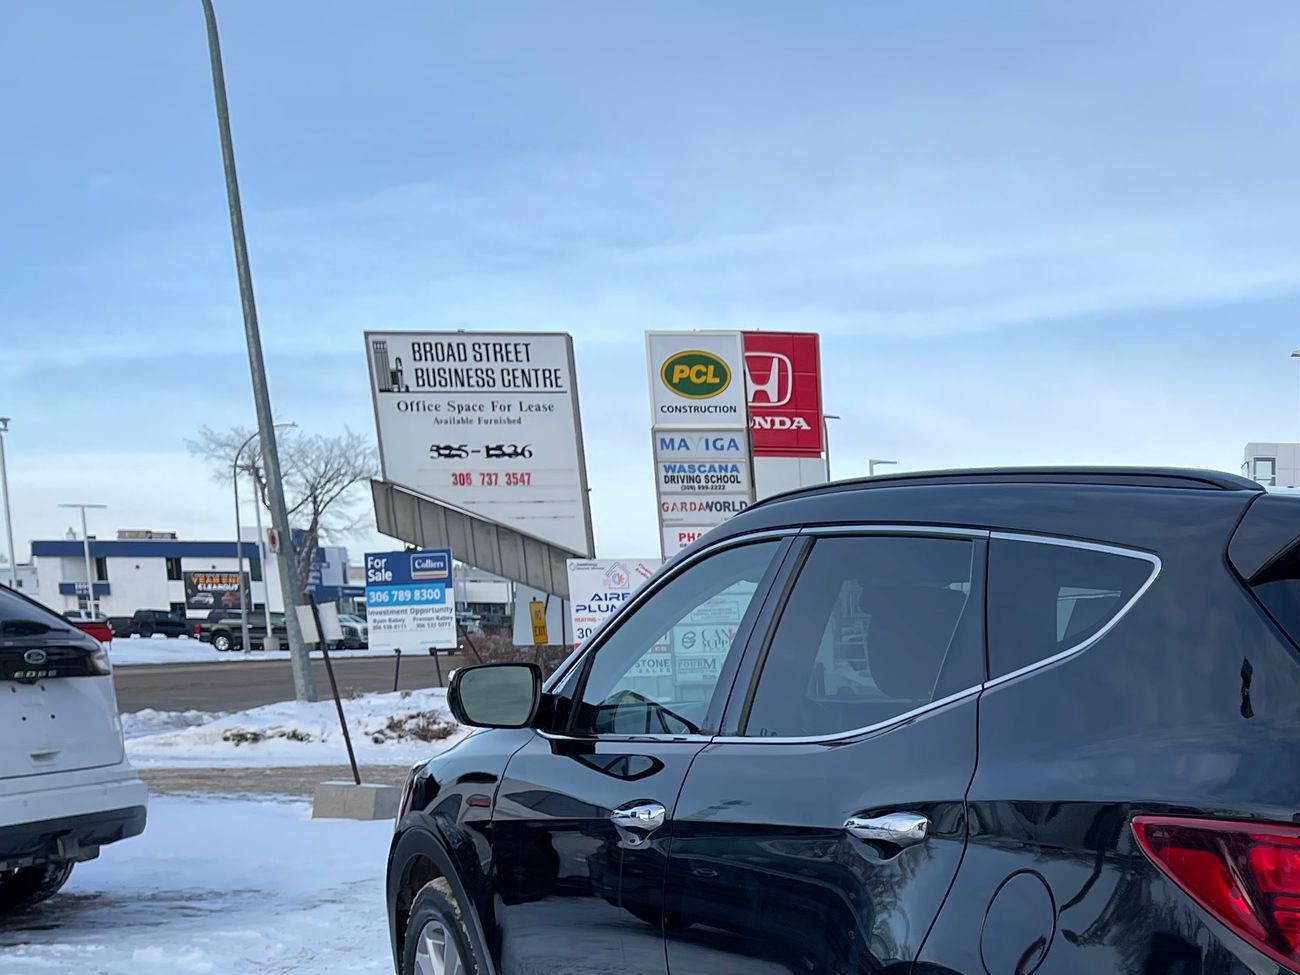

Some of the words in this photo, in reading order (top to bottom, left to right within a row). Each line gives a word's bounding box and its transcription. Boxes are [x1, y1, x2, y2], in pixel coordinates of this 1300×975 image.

[411, 342, 467, 362] BROAD
[472, 342, 531, 363] STREET
[415, 367, 496, 388] BUSINESS
[501, 368, 563, 388] CENTRE
[672, 364, 720, 384] PCL
[397, 400, 441, 412] Office
[447, 400, 485, 414] Space
[491, 401, 512, 412] For
[519, 401, 554, 412] Lease
[660, 405, 737, 413] CONSTRUCTION
[433, 417, 473, 425] Available
[478, 417, 522, 425] Furnished
[749, 416, 811, 430] NDA
[663, 464, 740, 473] WASCANA
[452, 473, 472, 486] 306
[480, 473, 498, 486] 737
[505, 473, 531, 486] 3547
[664, 475, 701, 484] DRIVING
[704, 474, 741, 484] SCHOOL
[367, 556, 387, 569] For
[414, 559, 444, 569] Colliers
[367, 569, 392, 582] Sale
[369, 591, 389, 603] 306
[391, 590, 411, 602] 789
[414, 588, 440, 601] 8300
[410, 607, 453, 617] Opportunity
